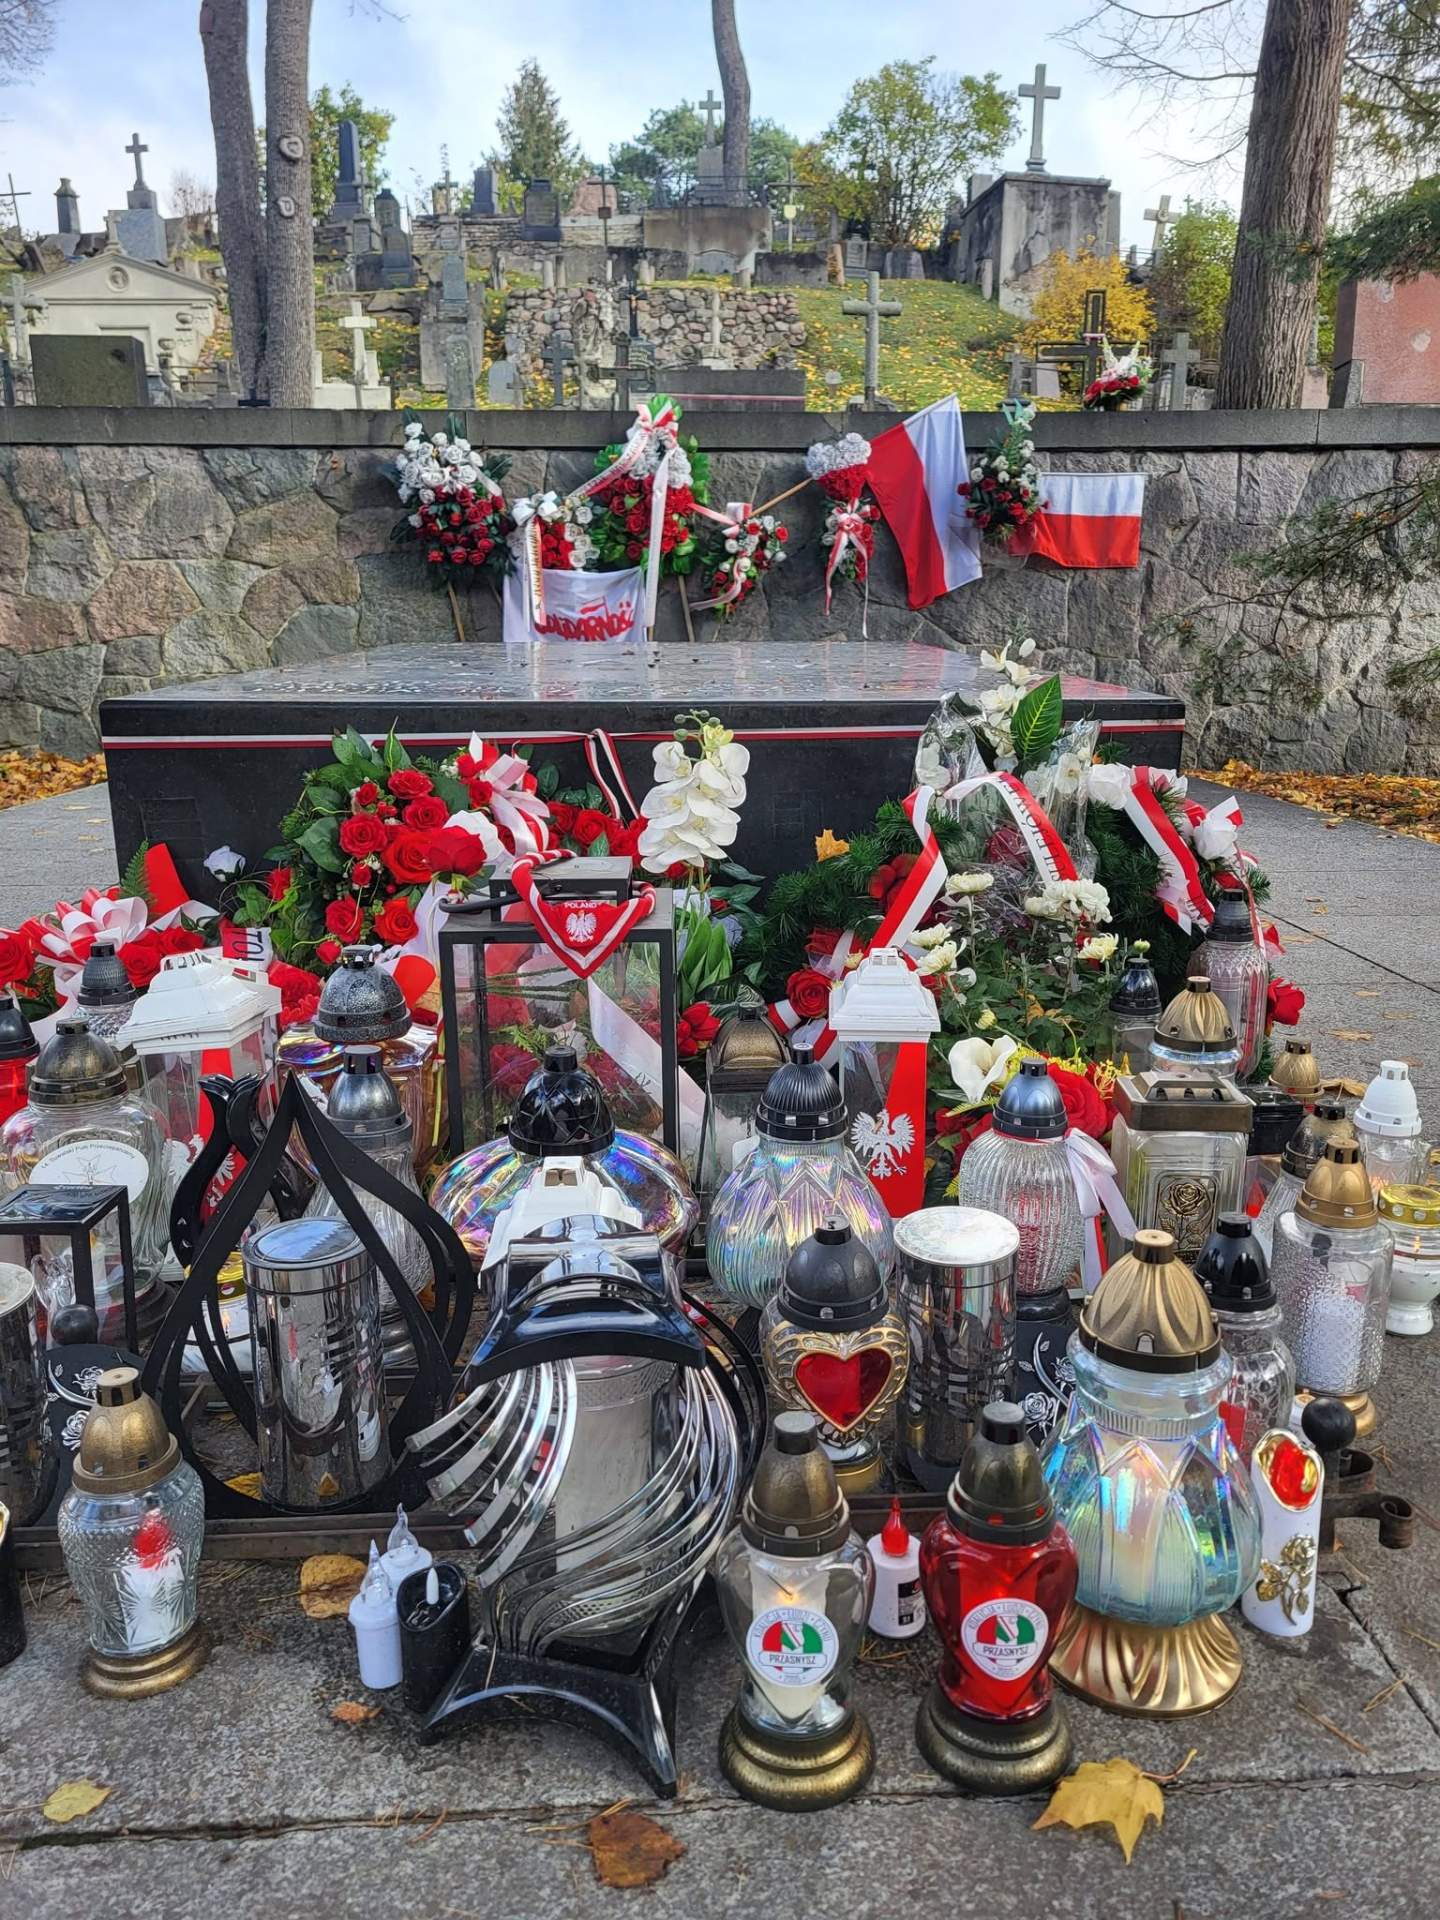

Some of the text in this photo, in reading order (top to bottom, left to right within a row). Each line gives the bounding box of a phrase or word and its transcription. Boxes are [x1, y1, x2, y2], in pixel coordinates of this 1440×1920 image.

[564, 901, 597, 909] POLAND
[983, 1645, 1029, 1656] PRZASNYSZ
[769, 1654, 816, 1665] PRZASNYSZ
